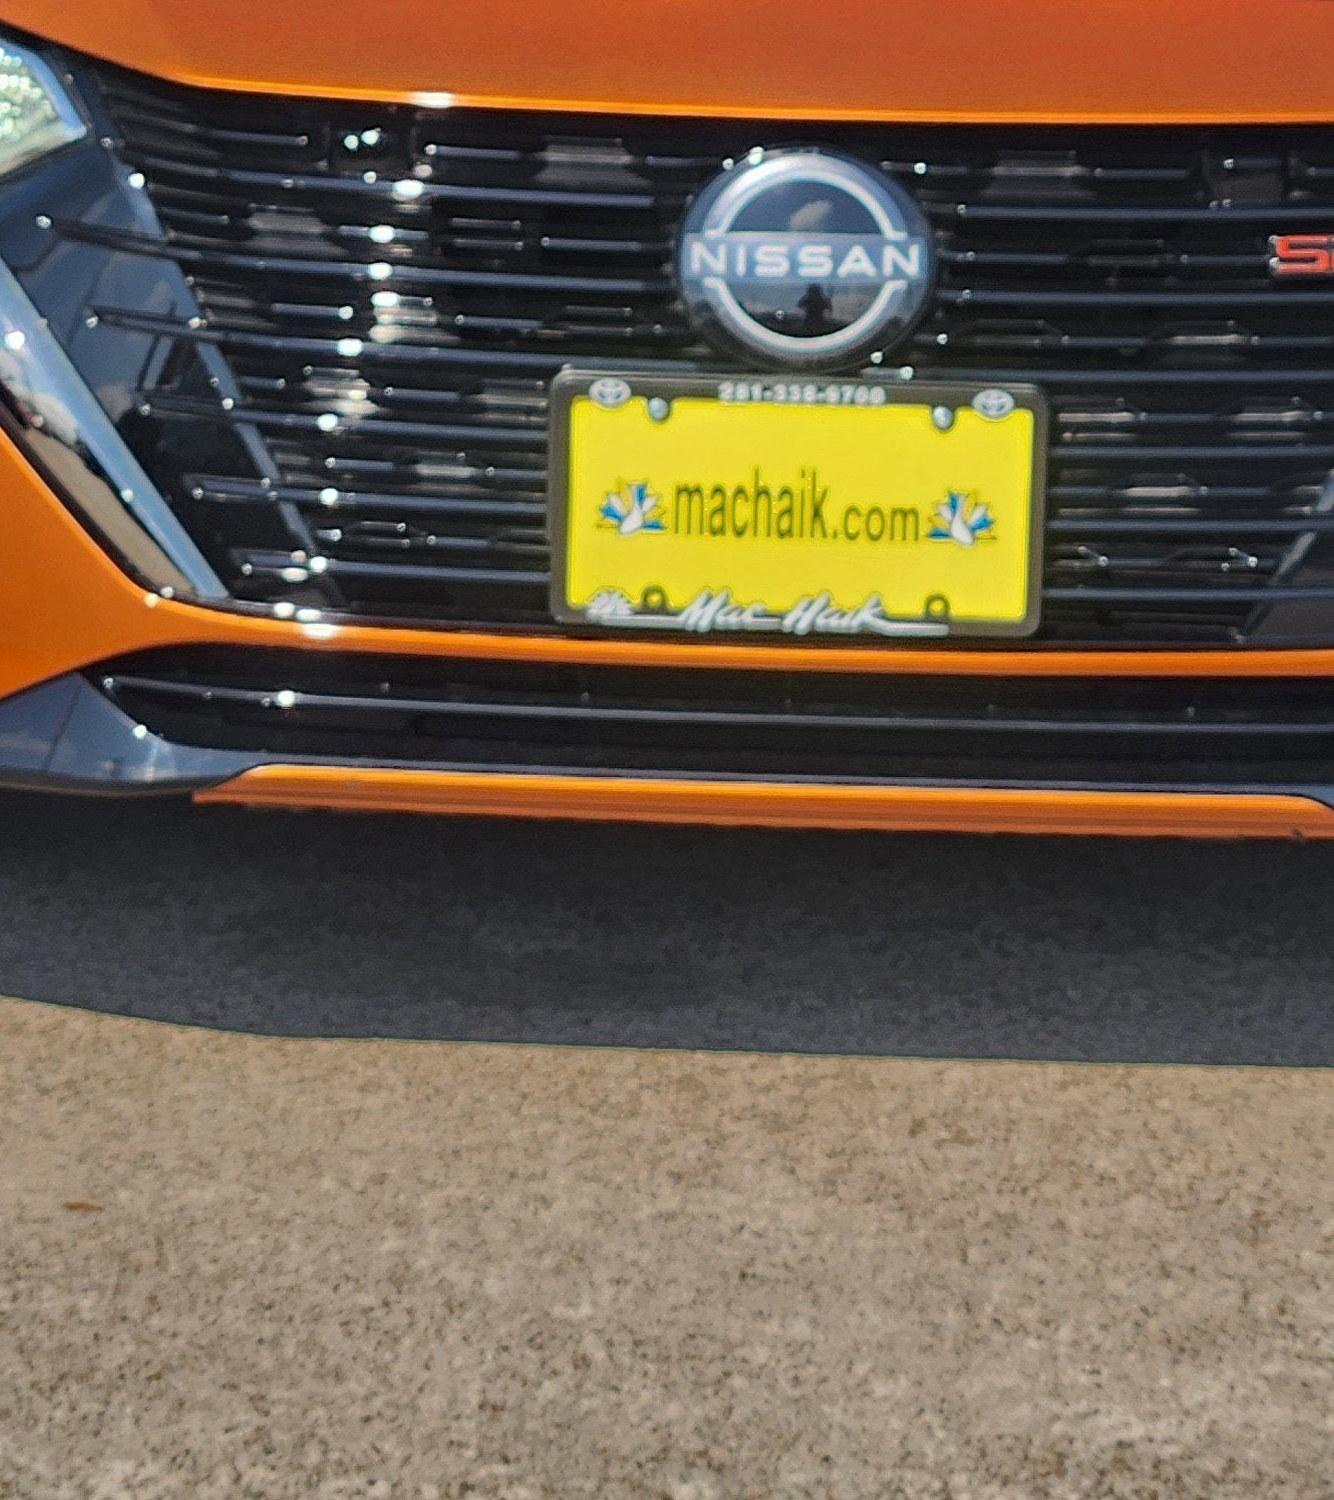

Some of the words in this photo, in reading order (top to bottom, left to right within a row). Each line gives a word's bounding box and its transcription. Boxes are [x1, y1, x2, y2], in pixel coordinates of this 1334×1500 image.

[690, 241, 921, 278] NISSAN
[673, 466, 921, 542] machaik.com
[678, 587, 770, 634] Mac
[782, 590, 889, 636] Haik
